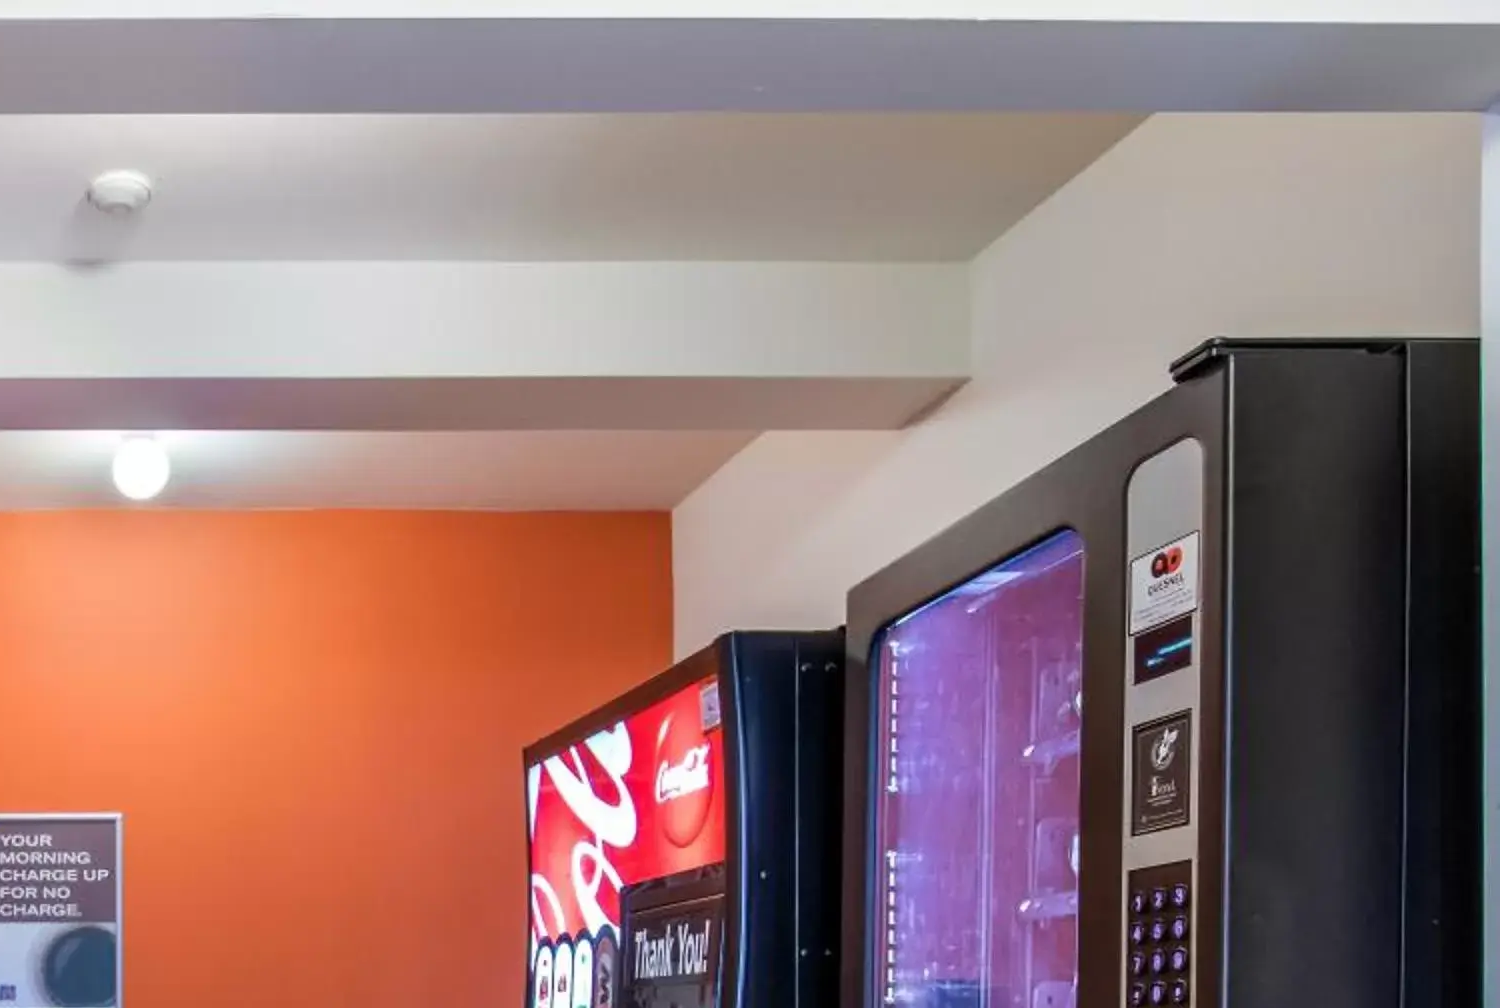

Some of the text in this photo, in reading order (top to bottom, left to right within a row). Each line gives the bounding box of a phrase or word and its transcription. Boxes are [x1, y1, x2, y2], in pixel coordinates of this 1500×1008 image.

[0, 834, 52, 847] YOUR
[0, 851, 92, 865] MORNING
[0, 869, 109, 882] CHARGE UP
[0, 886, 71, 899] FOR NO
[0, 903, 82, 917] CHARGE.
[634, 919, 711, 980] Thank You!
